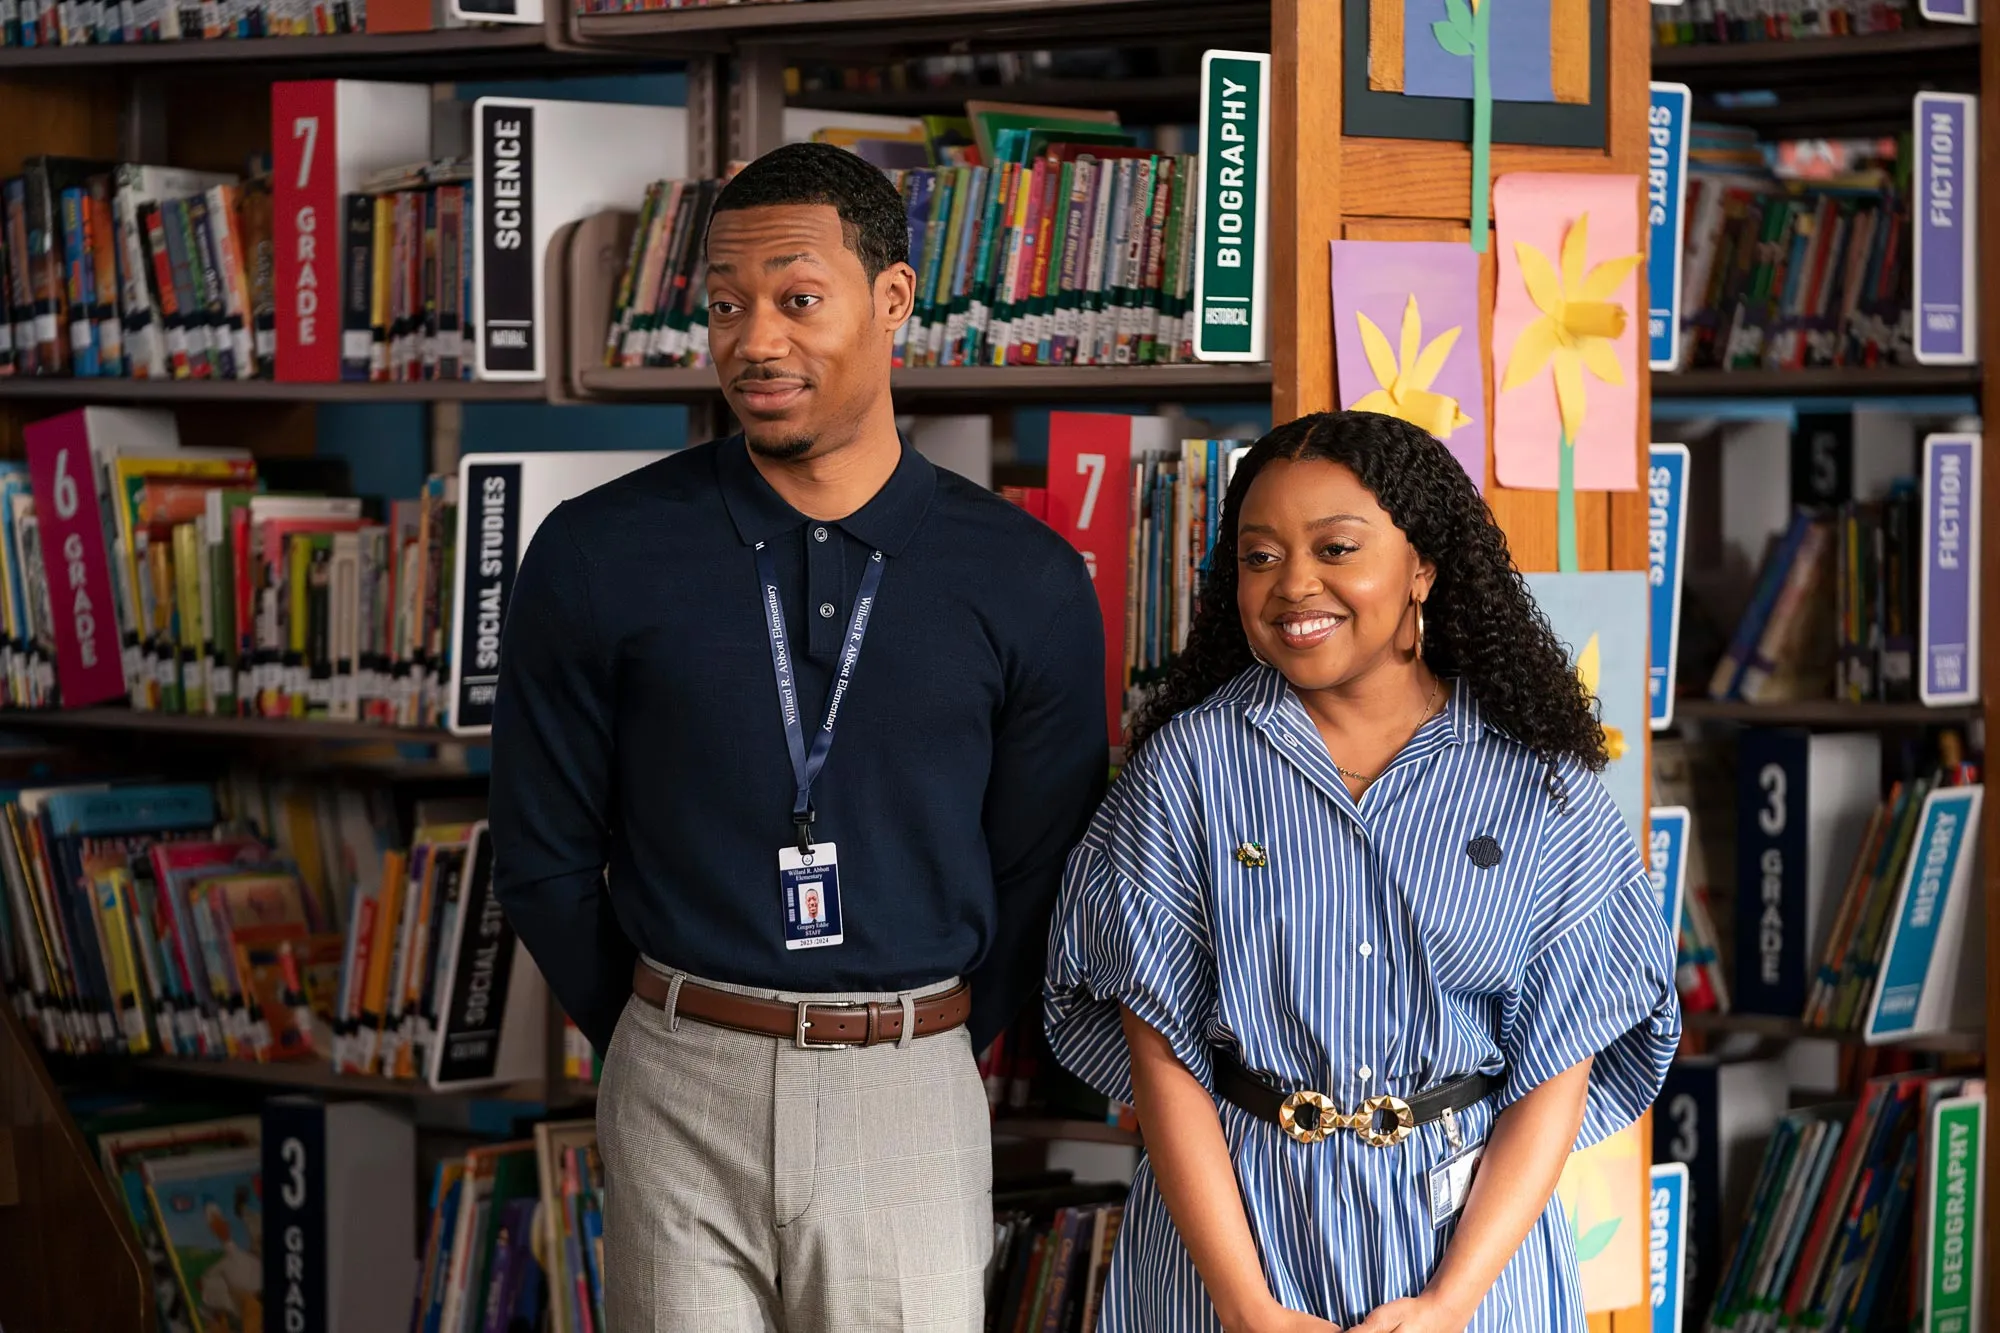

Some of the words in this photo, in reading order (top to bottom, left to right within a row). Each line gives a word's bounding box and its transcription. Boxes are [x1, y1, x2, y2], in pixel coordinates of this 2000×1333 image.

[293, 117, 318, 188] 7
[494, 119, 521, 249] SCIENCE
[1216, 77, 1247, 267] BIOGRAPHY
[1649, 105, 1671, 226] SPORTS
[1930, 113, 1953, 228] FICTION
[296, 207, 316, 345] GRADE
[53, 449, 77, 519] 6
[1077, 453, 1105, 529] 7
[1938, 454, 1961, 570] FICTION
[480, 476, 506, 577] STUDIES
[1649, 465, 1670, 587] SPORTS
[64, 535, 97, 668] GRADE
[475, 581, 502, 669] SOCIAL
[766, 584, 783, 638] Elementary
[849, 632, 861, 643] R.
[854, 597, 871, 630] Willard
[776, 640, 788, 673] Abbott
[780, 675, 791, 686] R.
[842, 644, 858, 677] Abbott
[783, 689, 796, 726] Willard
[823, 678, 849, 733] Elementary
[1759, 763, 1787, 836] 3
[787, 869, 806, 877] Willard
[1911, 811, 1957, 929] HISTORY
[1761, 849, 1782, 985] GRADE
[464, 940, 499, 1027] SOCIAL
[1670, 1094, 1698, 1163] 3
[281, 1137, 306, 1210] 3
[1941, 1121, 1970, 1295] GEOGRAPHY
[1650, 1187, 1670, 1308] SPORTS
